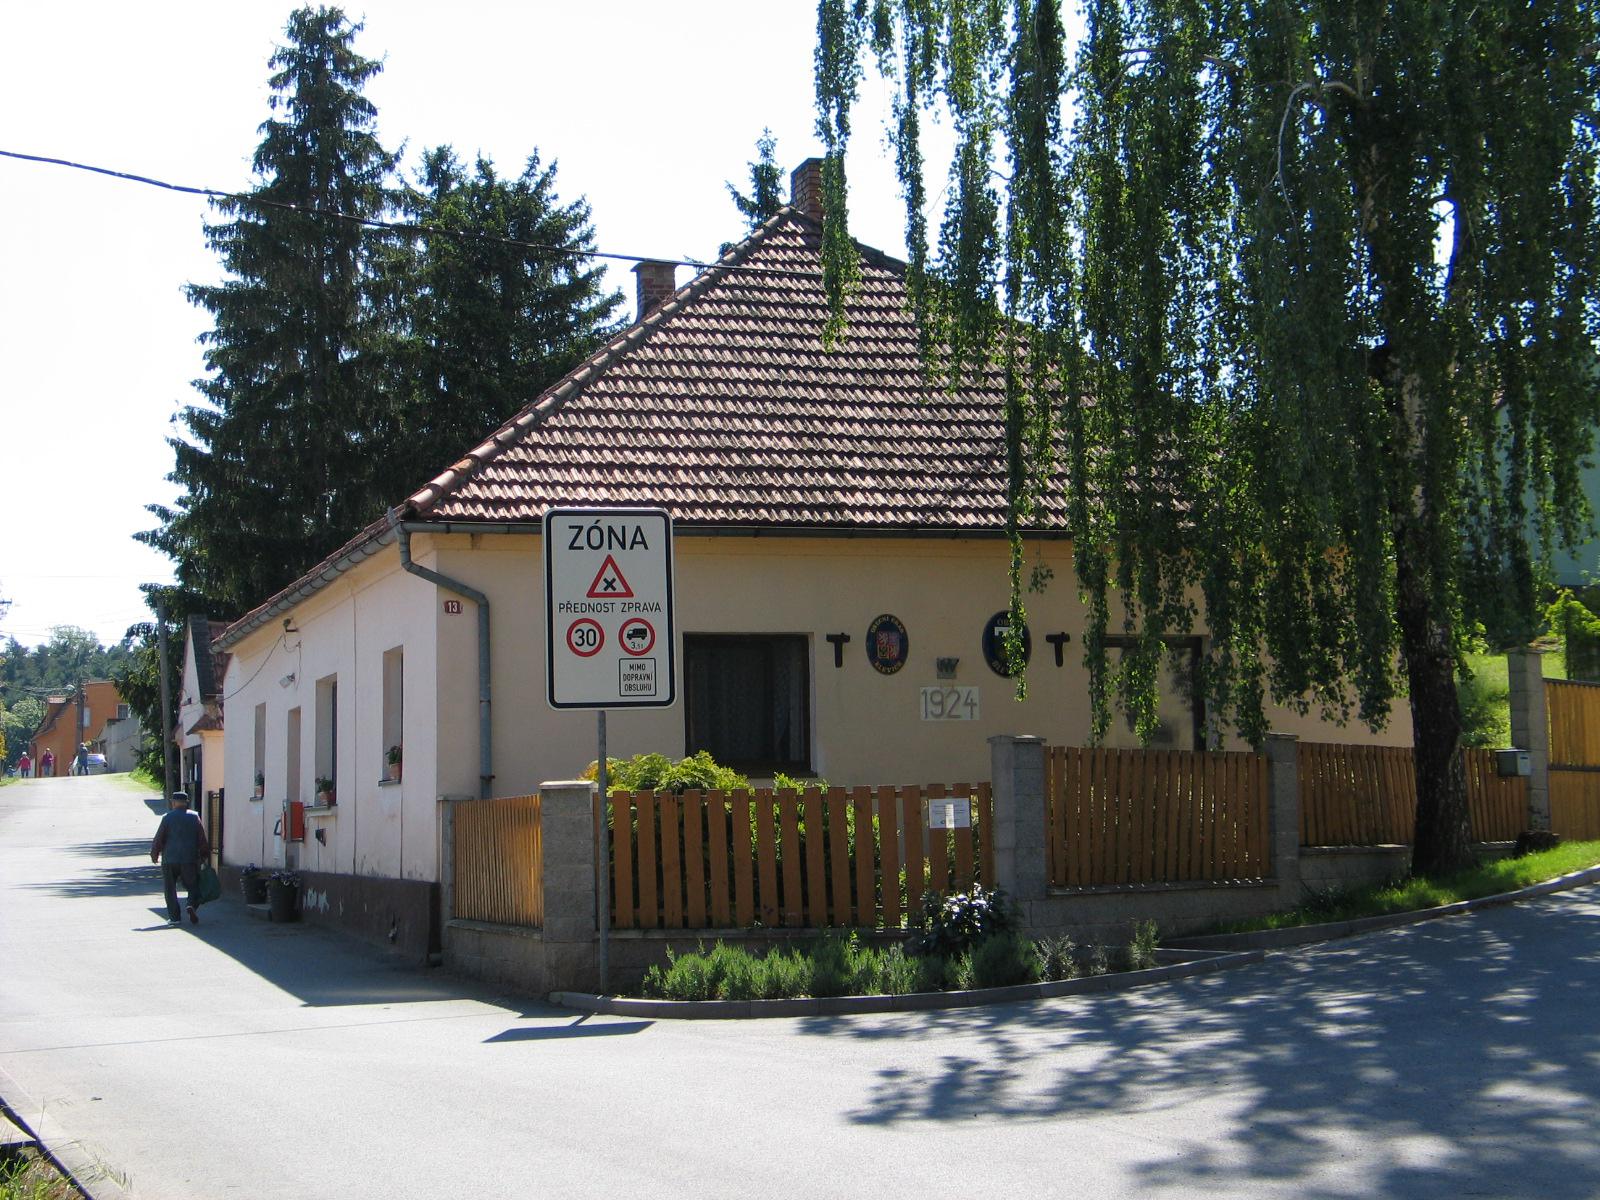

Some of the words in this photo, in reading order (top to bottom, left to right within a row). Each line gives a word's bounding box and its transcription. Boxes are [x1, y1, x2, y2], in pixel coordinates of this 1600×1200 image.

[568, 519, 649, 550] ZÓNA
[447, 601, 458, 613] 13
[558, 600, 616, 614] PŘEDNOST
[620, 601, 662, 613] ZPRAVA
[574, 628, 597, 647] 30
[629, 663, 646, 671] MIMO
[622, 672, 653, 681] DOPRAVNÍ
[624, 683, 652, 692] OBSLUHU
[921, 689, 978, 720] 1924
